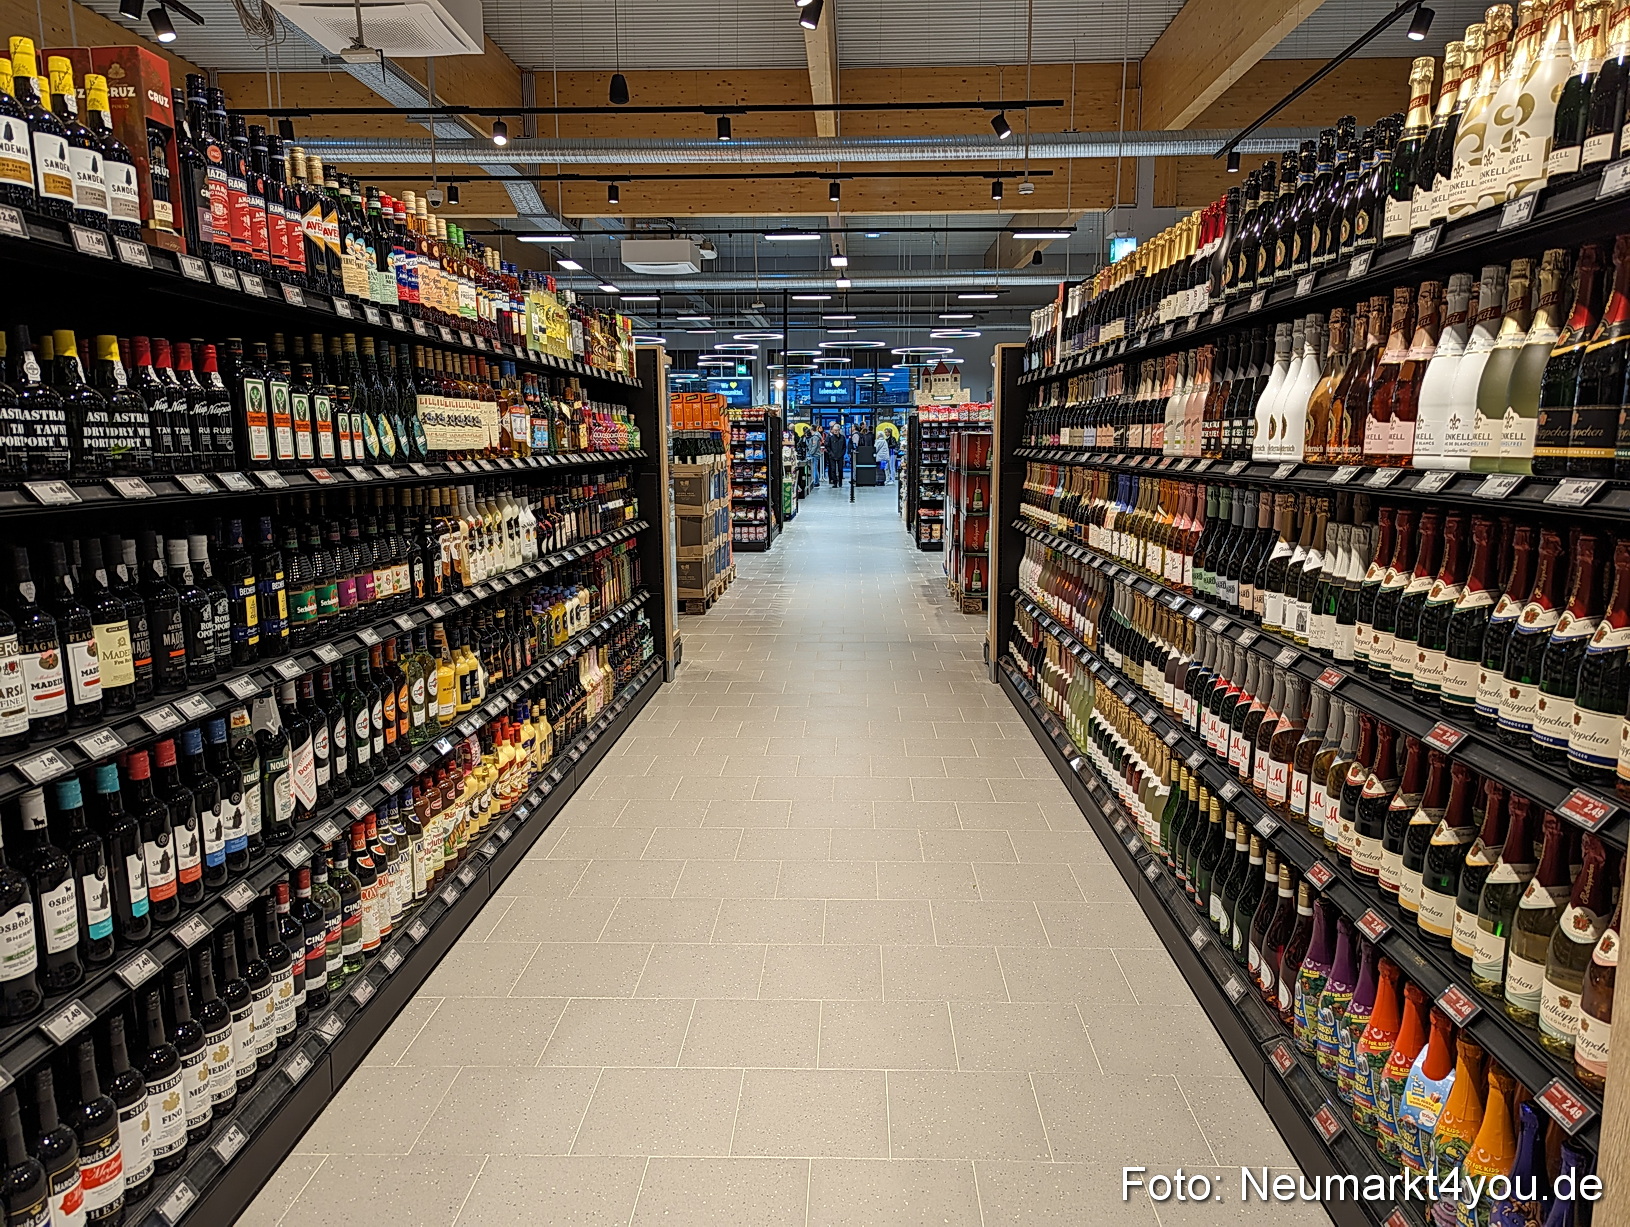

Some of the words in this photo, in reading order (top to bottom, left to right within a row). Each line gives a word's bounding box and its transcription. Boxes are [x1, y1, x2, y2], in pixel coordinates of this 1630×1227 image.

[147, 89, 170, 109] CRUZ
[1, 210, 18, 224] 2.99
[92, 733, 112, 746] 12.99
[1442, 730, 1458, 744] 2.49
[40, 755, 59, 768] 7.99
[1583, 803, 1605, 819] 2.49
[136, 957, 151, 971] 7.49
[1456, 1001, 1472, 1015] 2.49
[64, 1009, 82, 1023] 7.49
[162, 1108, 183, 1126] FINO
[1561, 1101, 1584, 1119] 2.49
[228, 1128, 241, 1144] 4.79
[174, 1186, 190, 1202] 4.79
